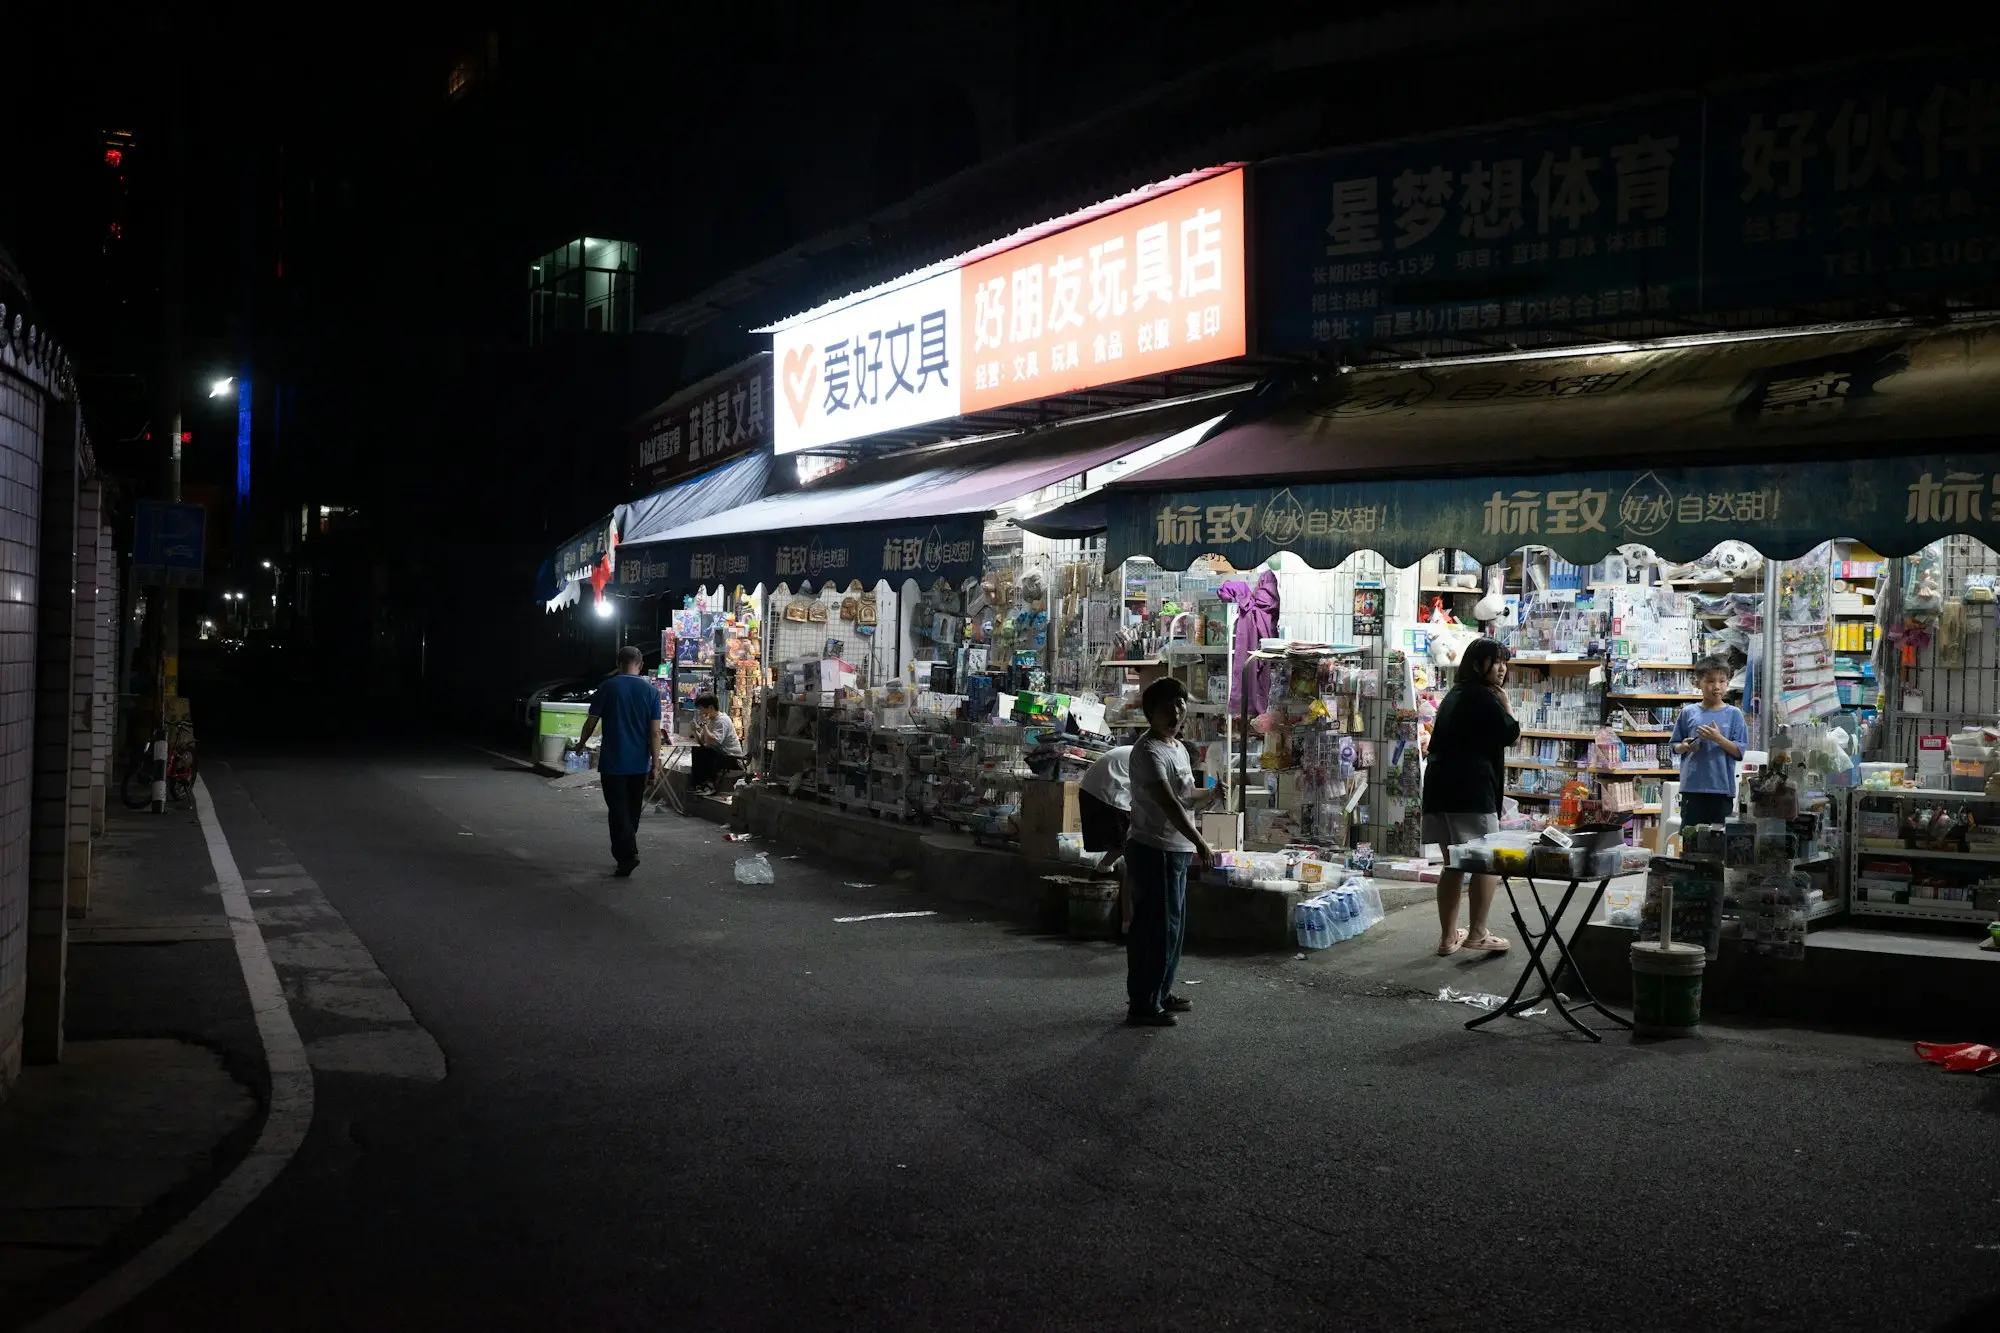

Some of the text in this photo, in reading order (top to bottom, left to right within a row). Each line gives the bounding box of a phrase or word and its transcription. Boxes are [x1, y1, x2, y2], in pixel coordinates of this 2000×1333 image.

[1326, 133, 1679, 256] 星梦想体育
[973, 208, 1221, 354] 好朋友玩具店
[823, 309, 949, 416] 爱好文具
[1013, 351, 1039, 382] 文具
[1051, 340, 1079, 373] 玩具
[1093, 330, 1123, 364] 食品
[1138, 318, 1170, 353] 校服
[688, 375, 764, 462] 蓝精灵文具
[1156, 503, 1254, 546] 标致
[1481, 487, 1608, 535] 标致
[1905, 472, 2000, 523] 标
[776, 545, 807, 575] 标致
[883, 537, 924, 571] 标致
